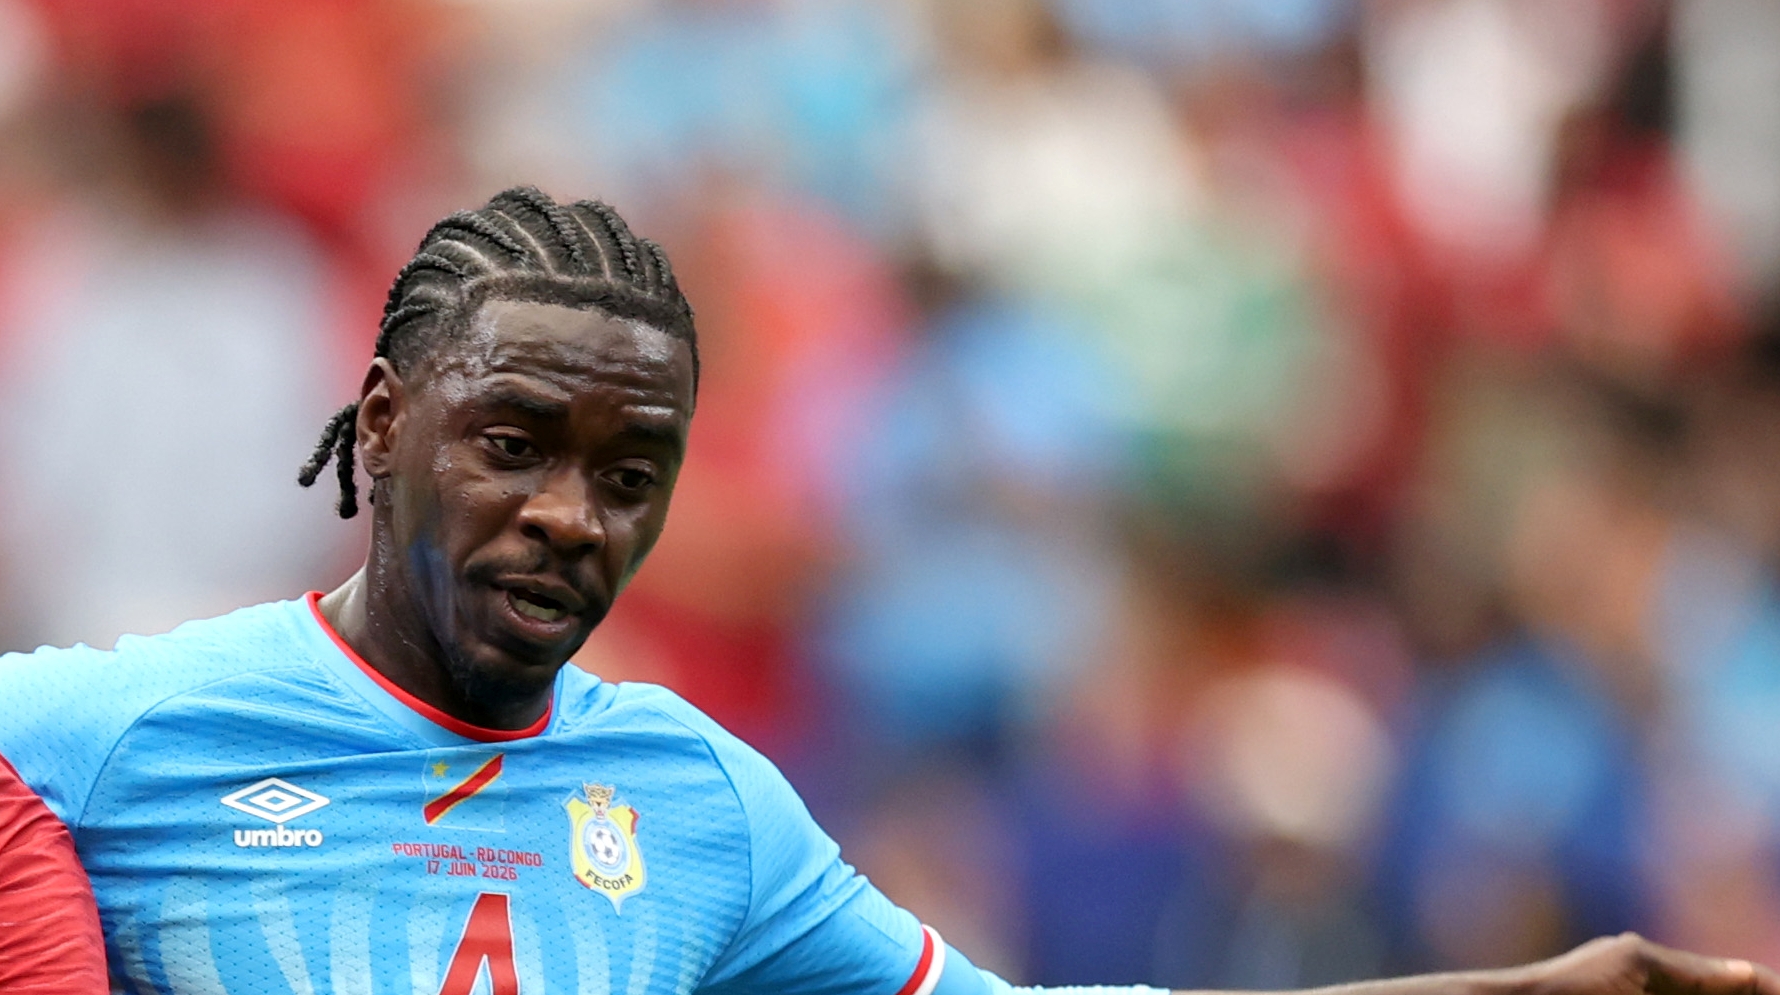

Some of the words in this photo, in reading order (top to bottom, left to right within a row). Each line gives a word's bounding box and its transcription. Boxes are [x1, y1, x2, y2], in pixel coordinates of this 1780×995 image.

[233, 824, 324, 848] umbro
[392, 843, 467, 861] PORTUGAL
[427, 860, 441, 875] 17
[446, 862, 477, 877] JUIN
[481, 864, 518, 881] 2026
[585, 869, 634, 891] FECOFA
